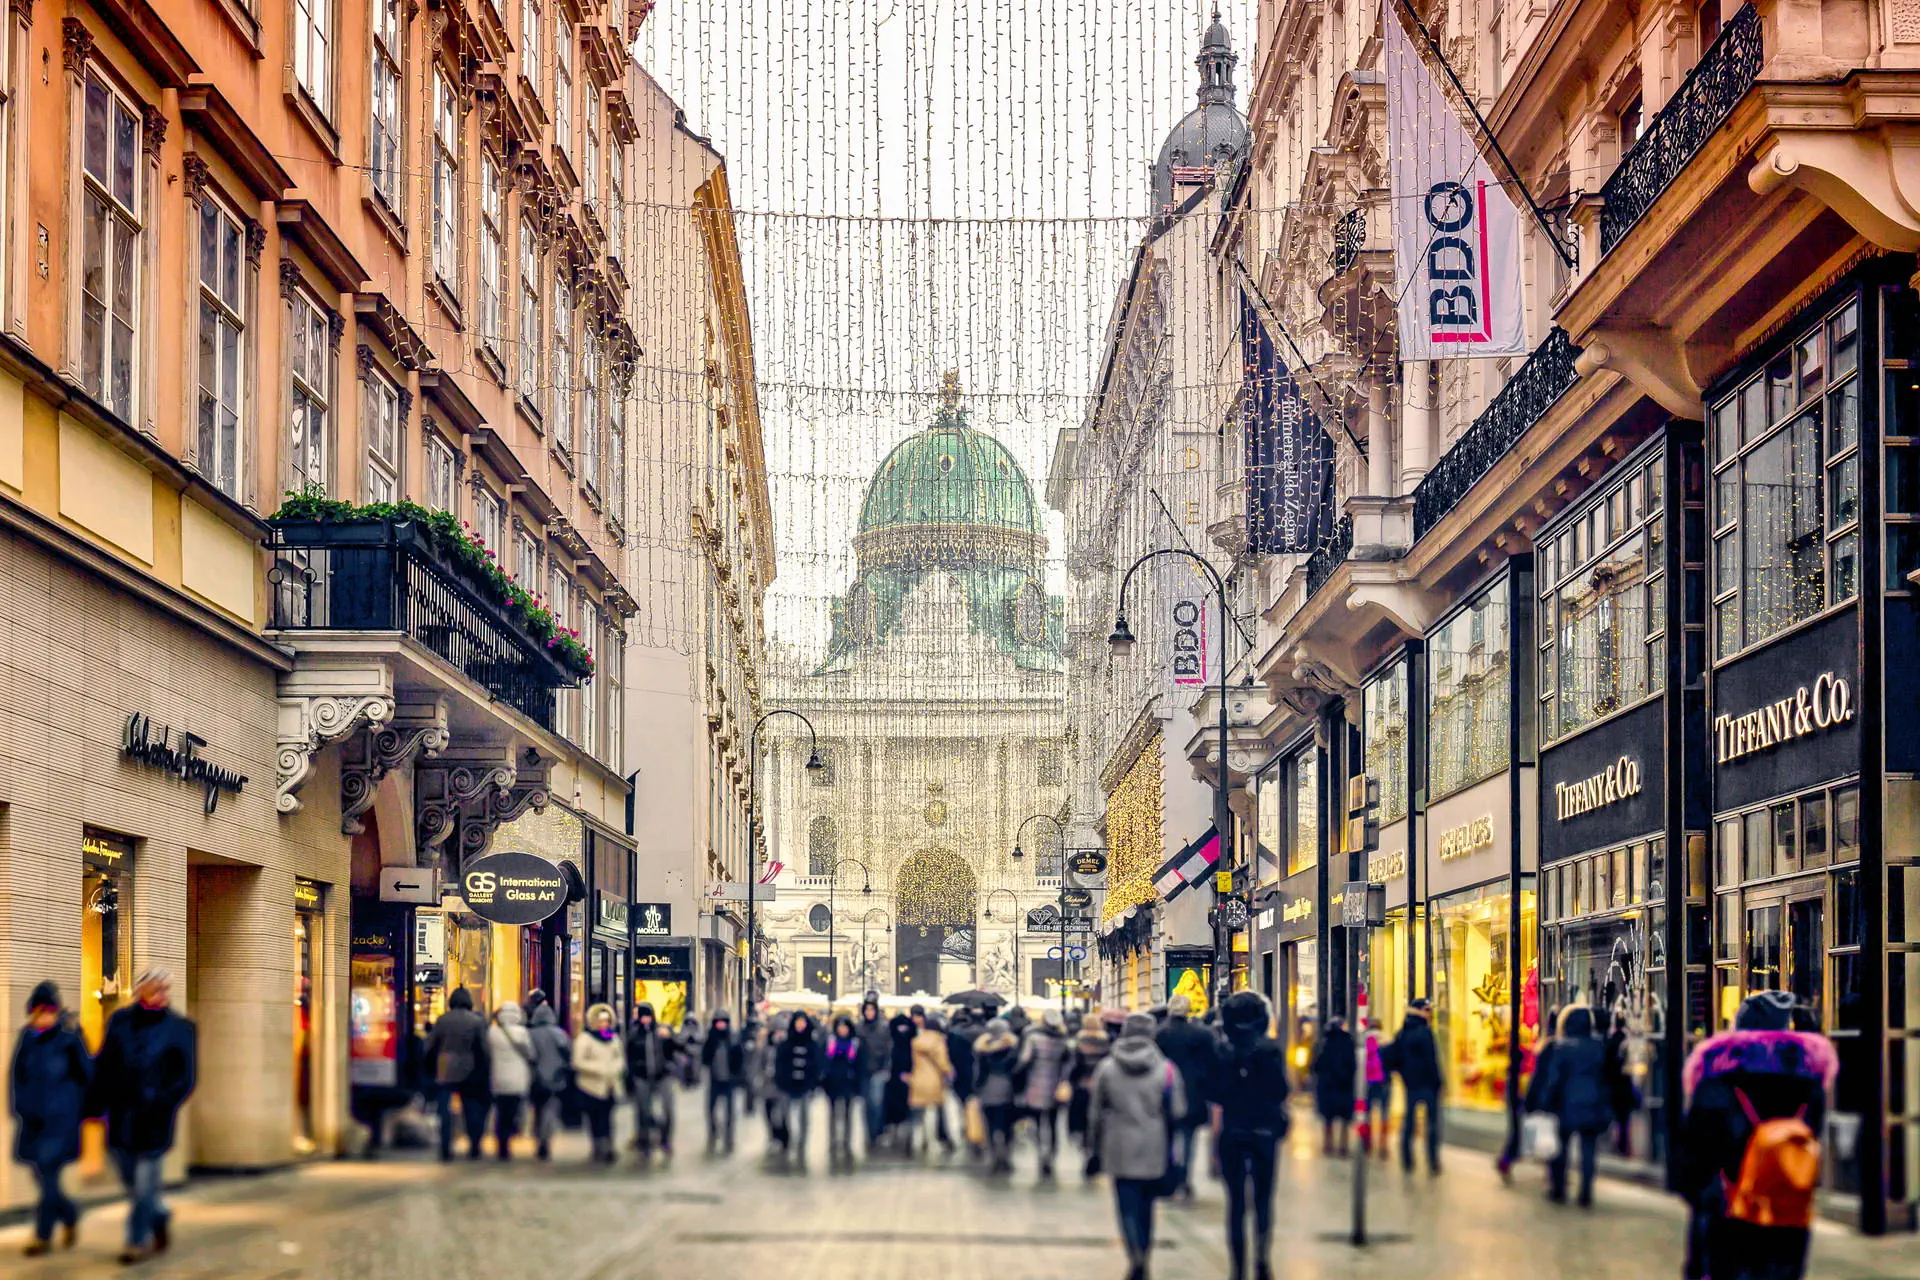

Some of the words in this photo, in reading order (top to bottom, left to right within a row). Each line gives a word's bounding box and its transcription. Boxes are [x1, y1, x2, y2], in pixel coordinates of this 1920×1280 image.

[1424, 181, 1477, 325] BDO
[1281, 500, 1300, 545] Zegna
[1173, 600, 1200, 675] BDO
[499, 876, 561, 888] International
[506, 889, 536, 901] Glass
[538, 889, 555, 901] Art
[648, 954, 671, 965] Dutti
